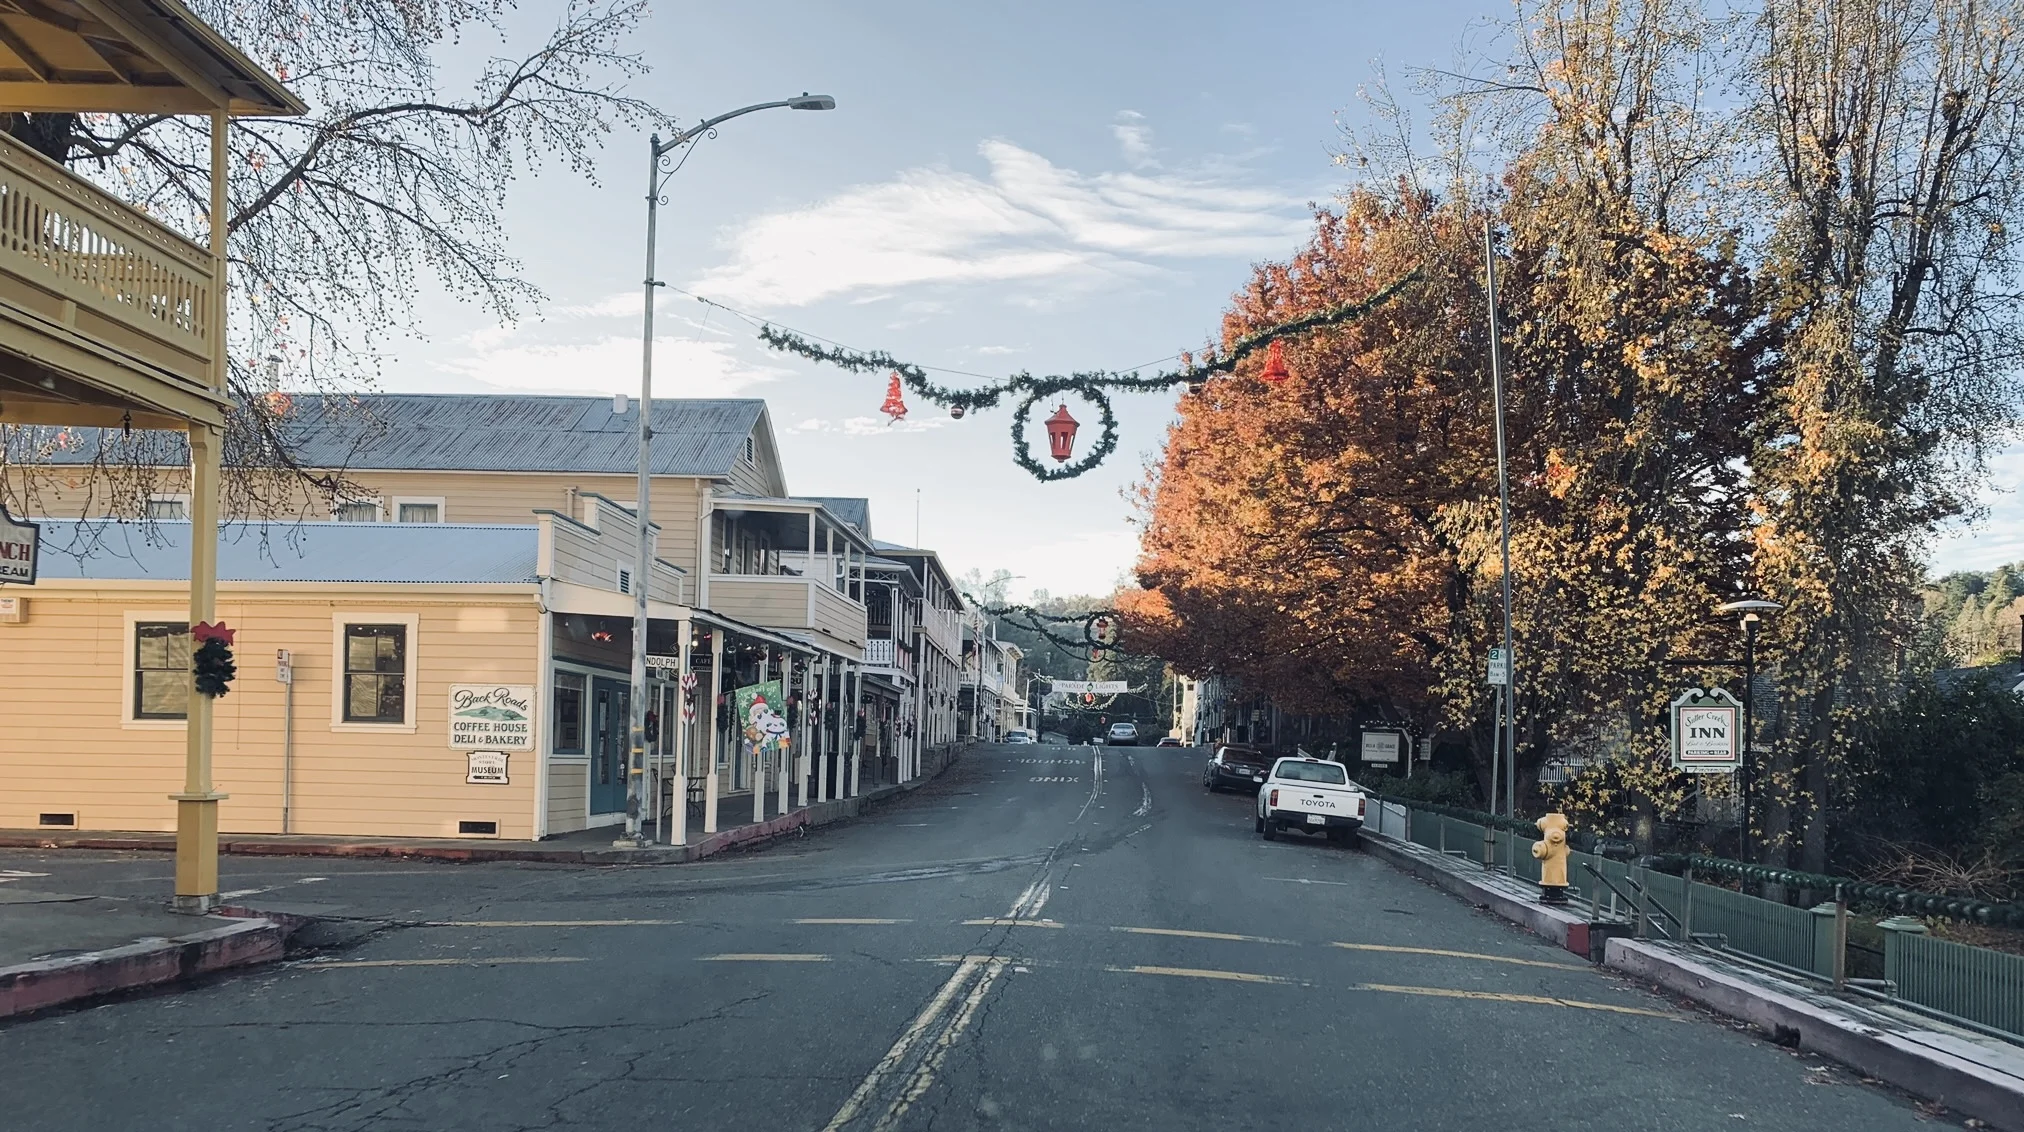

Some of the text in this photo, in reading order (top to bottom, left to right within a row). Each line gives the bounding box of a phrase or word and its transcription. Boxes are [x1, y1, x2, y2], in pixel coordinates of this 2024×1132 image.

[1491, 650, 1498, 659] 2
[646, 656, 676, 667] NDOLPH
[454, 687, 529, 711] Back Roads
[1706, 711, 1730, 727] Creek
[453, 721, 528, 733] COFFEE HOUSE
[1689, 727, 1725, 739] INN
[454, 734, 476, 744] DELI
[485, 735, 528, 745] BAKERY
[471, 766, 504, 774] MUSEUM
[1300, 799, 1336, 809] TOYOTA
